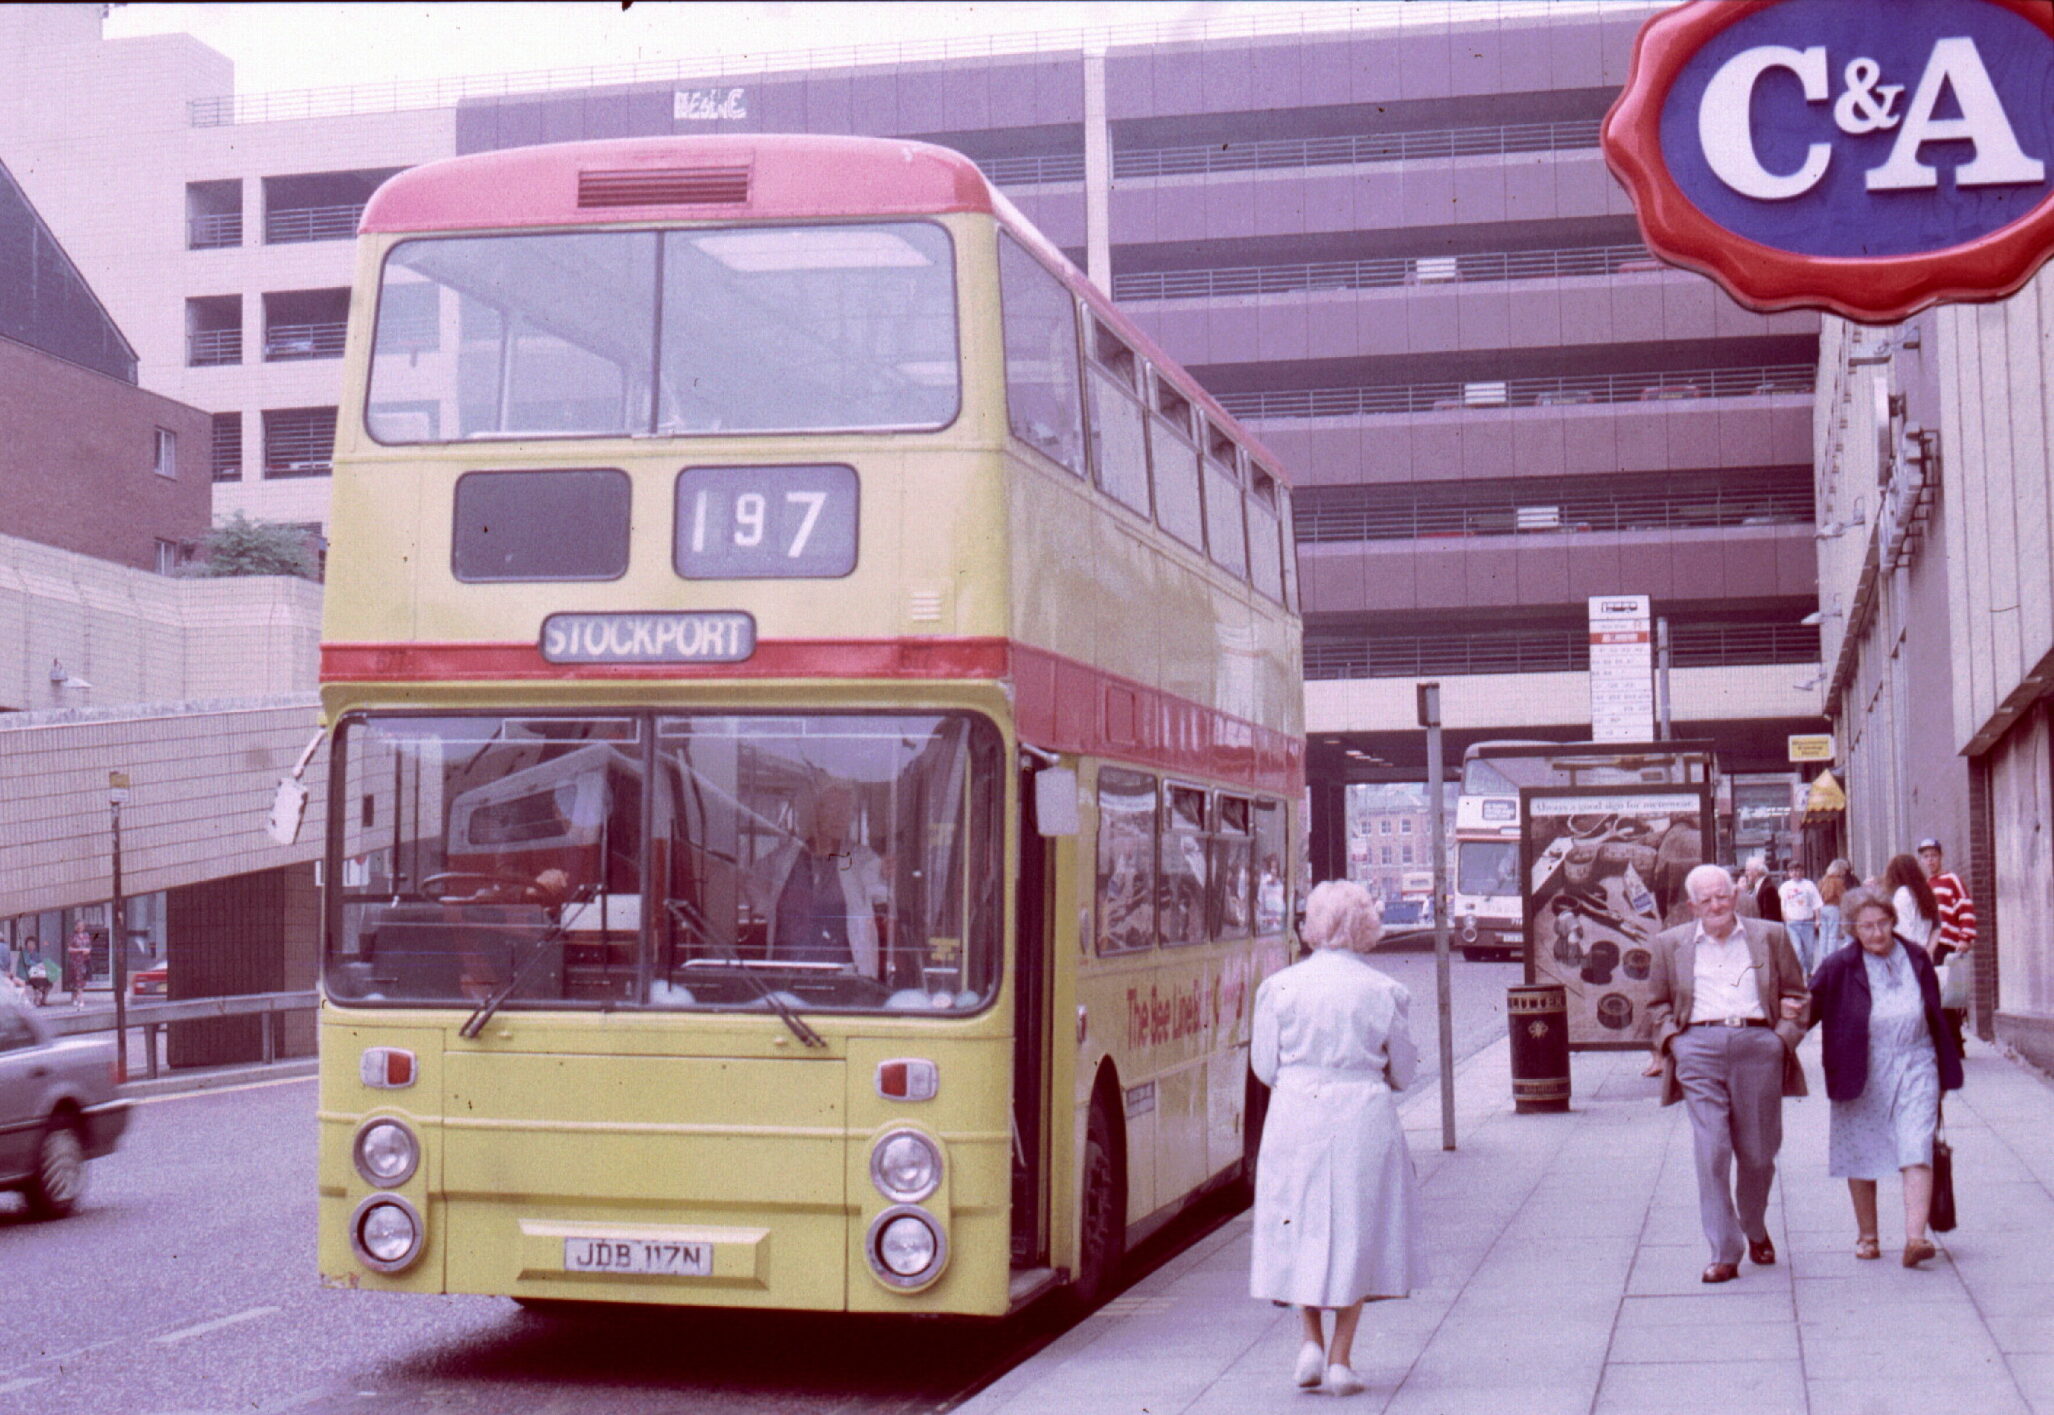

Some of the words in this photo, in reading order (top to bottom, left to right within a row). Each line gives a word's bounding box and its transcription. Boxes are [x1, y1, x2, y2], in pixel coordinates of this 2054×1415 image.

[1698, 36, 2046, 200] C&A
[691, 489, 828, 559] 197
[548, 617, 748, 658] STOCKPORT
[1126, 987, 1150, 1051] The
[1151, 984, 1171, 1046] Bee
[1509, 996, 1565, 1011] LITTER
[576, 1242, 632, 1268] JDB
[644, 1244, 702, 1266] 117N
